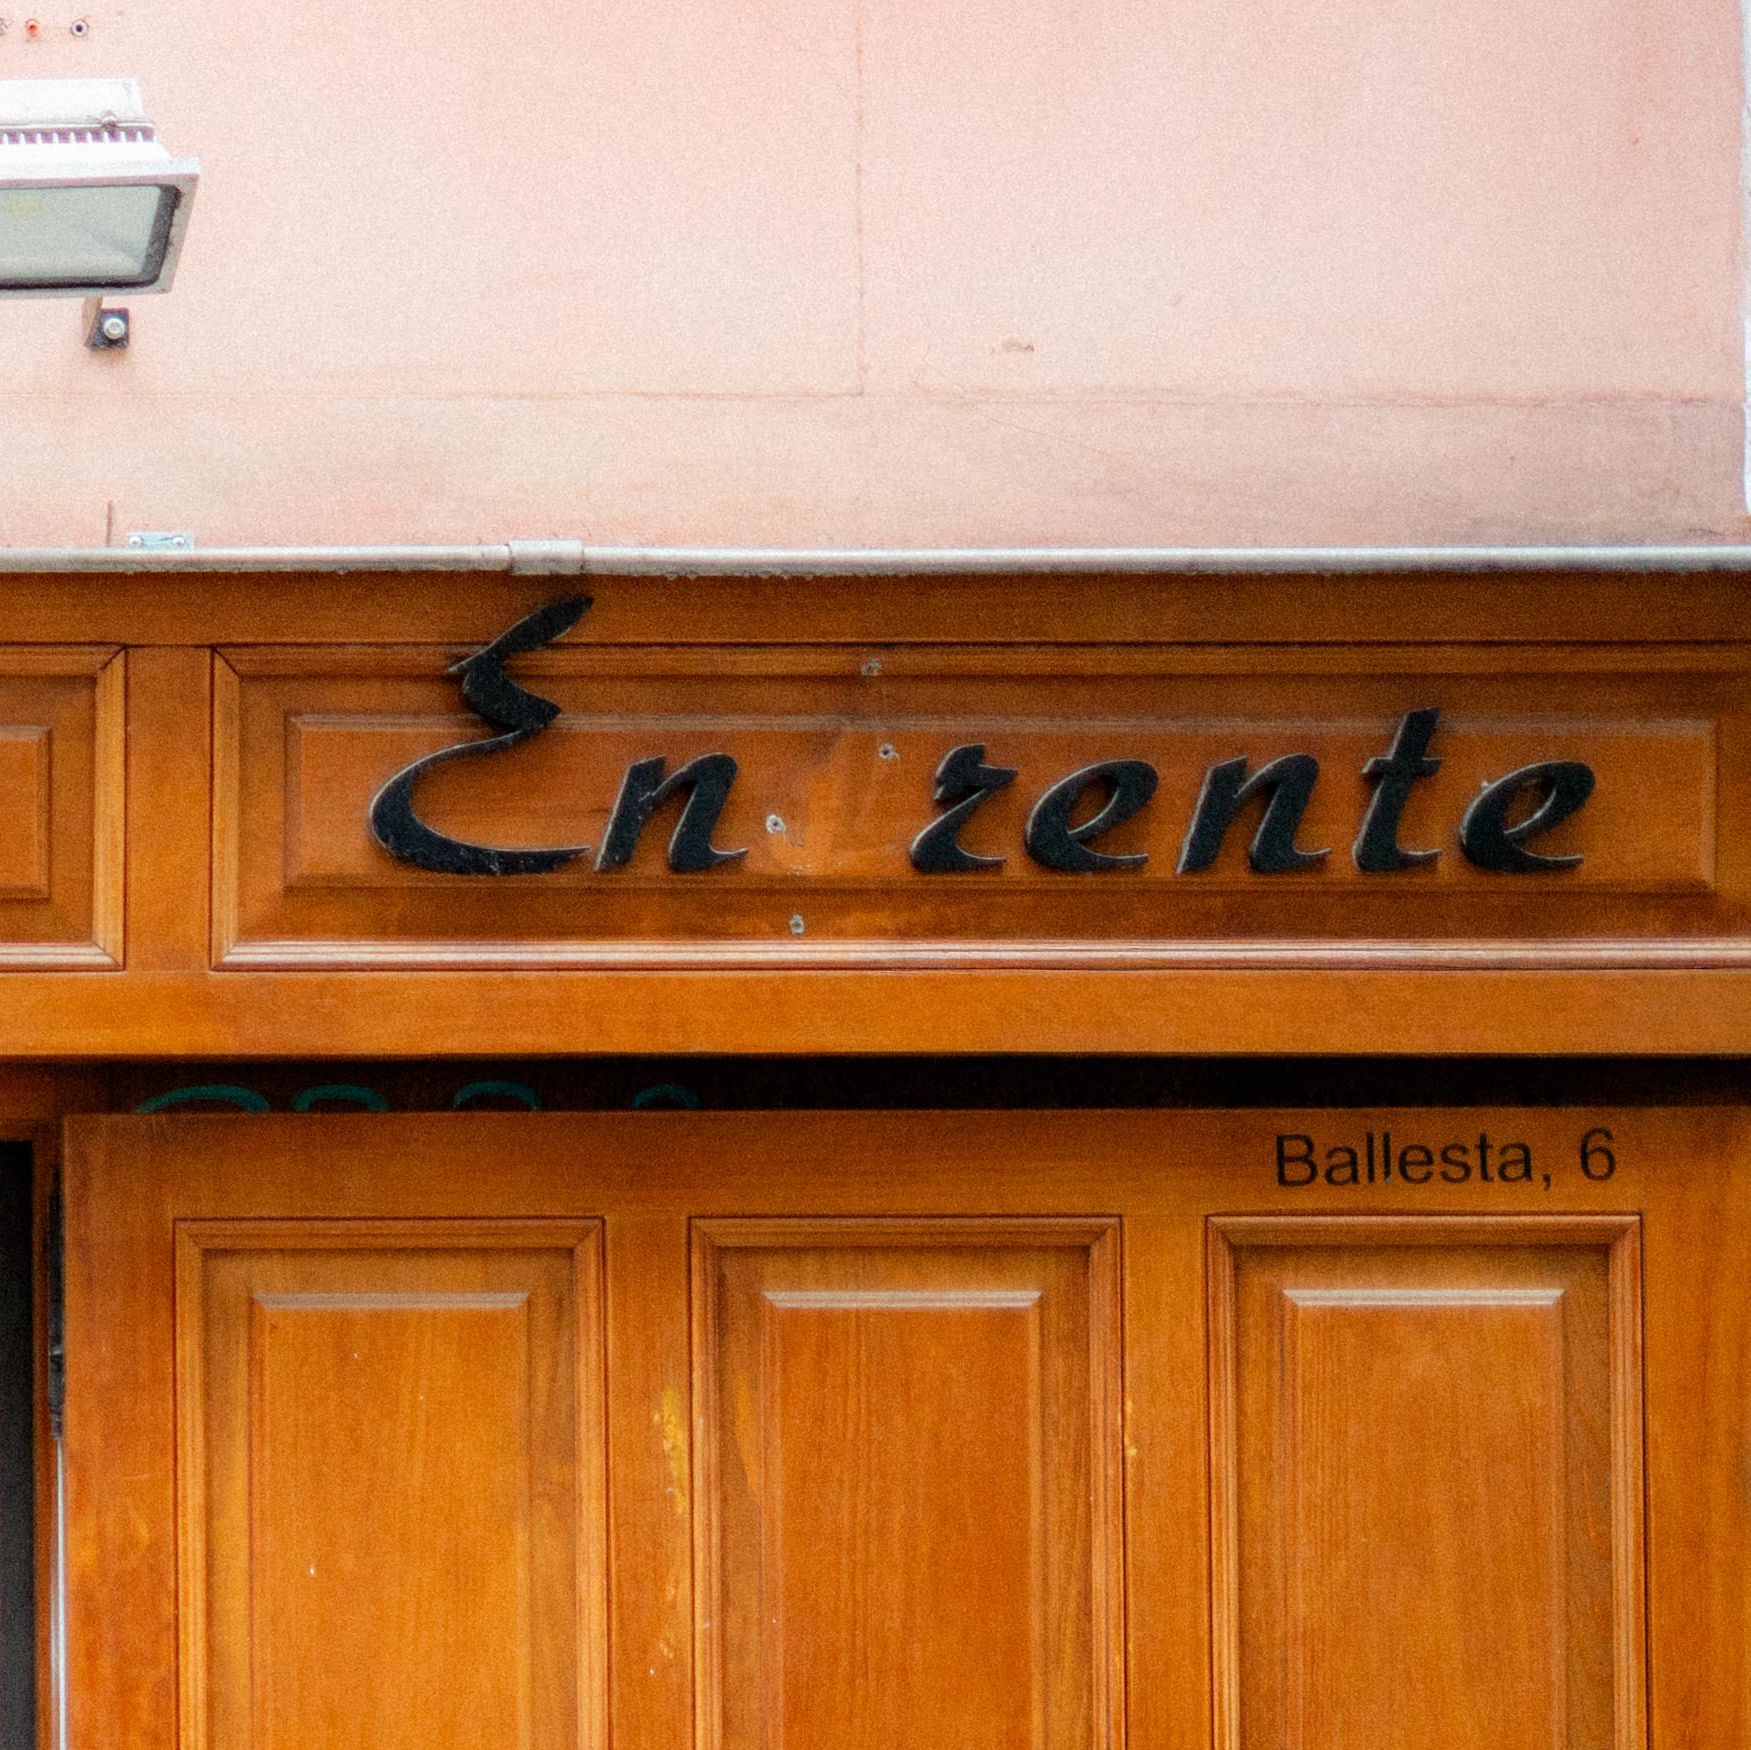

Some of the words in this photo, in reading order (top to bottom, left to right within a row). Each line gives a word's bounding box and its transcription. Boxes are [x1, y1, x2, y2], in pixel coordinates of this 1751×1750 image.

[369, 594, 750, 876] En
[909, 707, 1597, 875] rente
[1275, 1131, 1552, 1191] Ballesta,
[1580, 1127, 1617, 1182] 6
